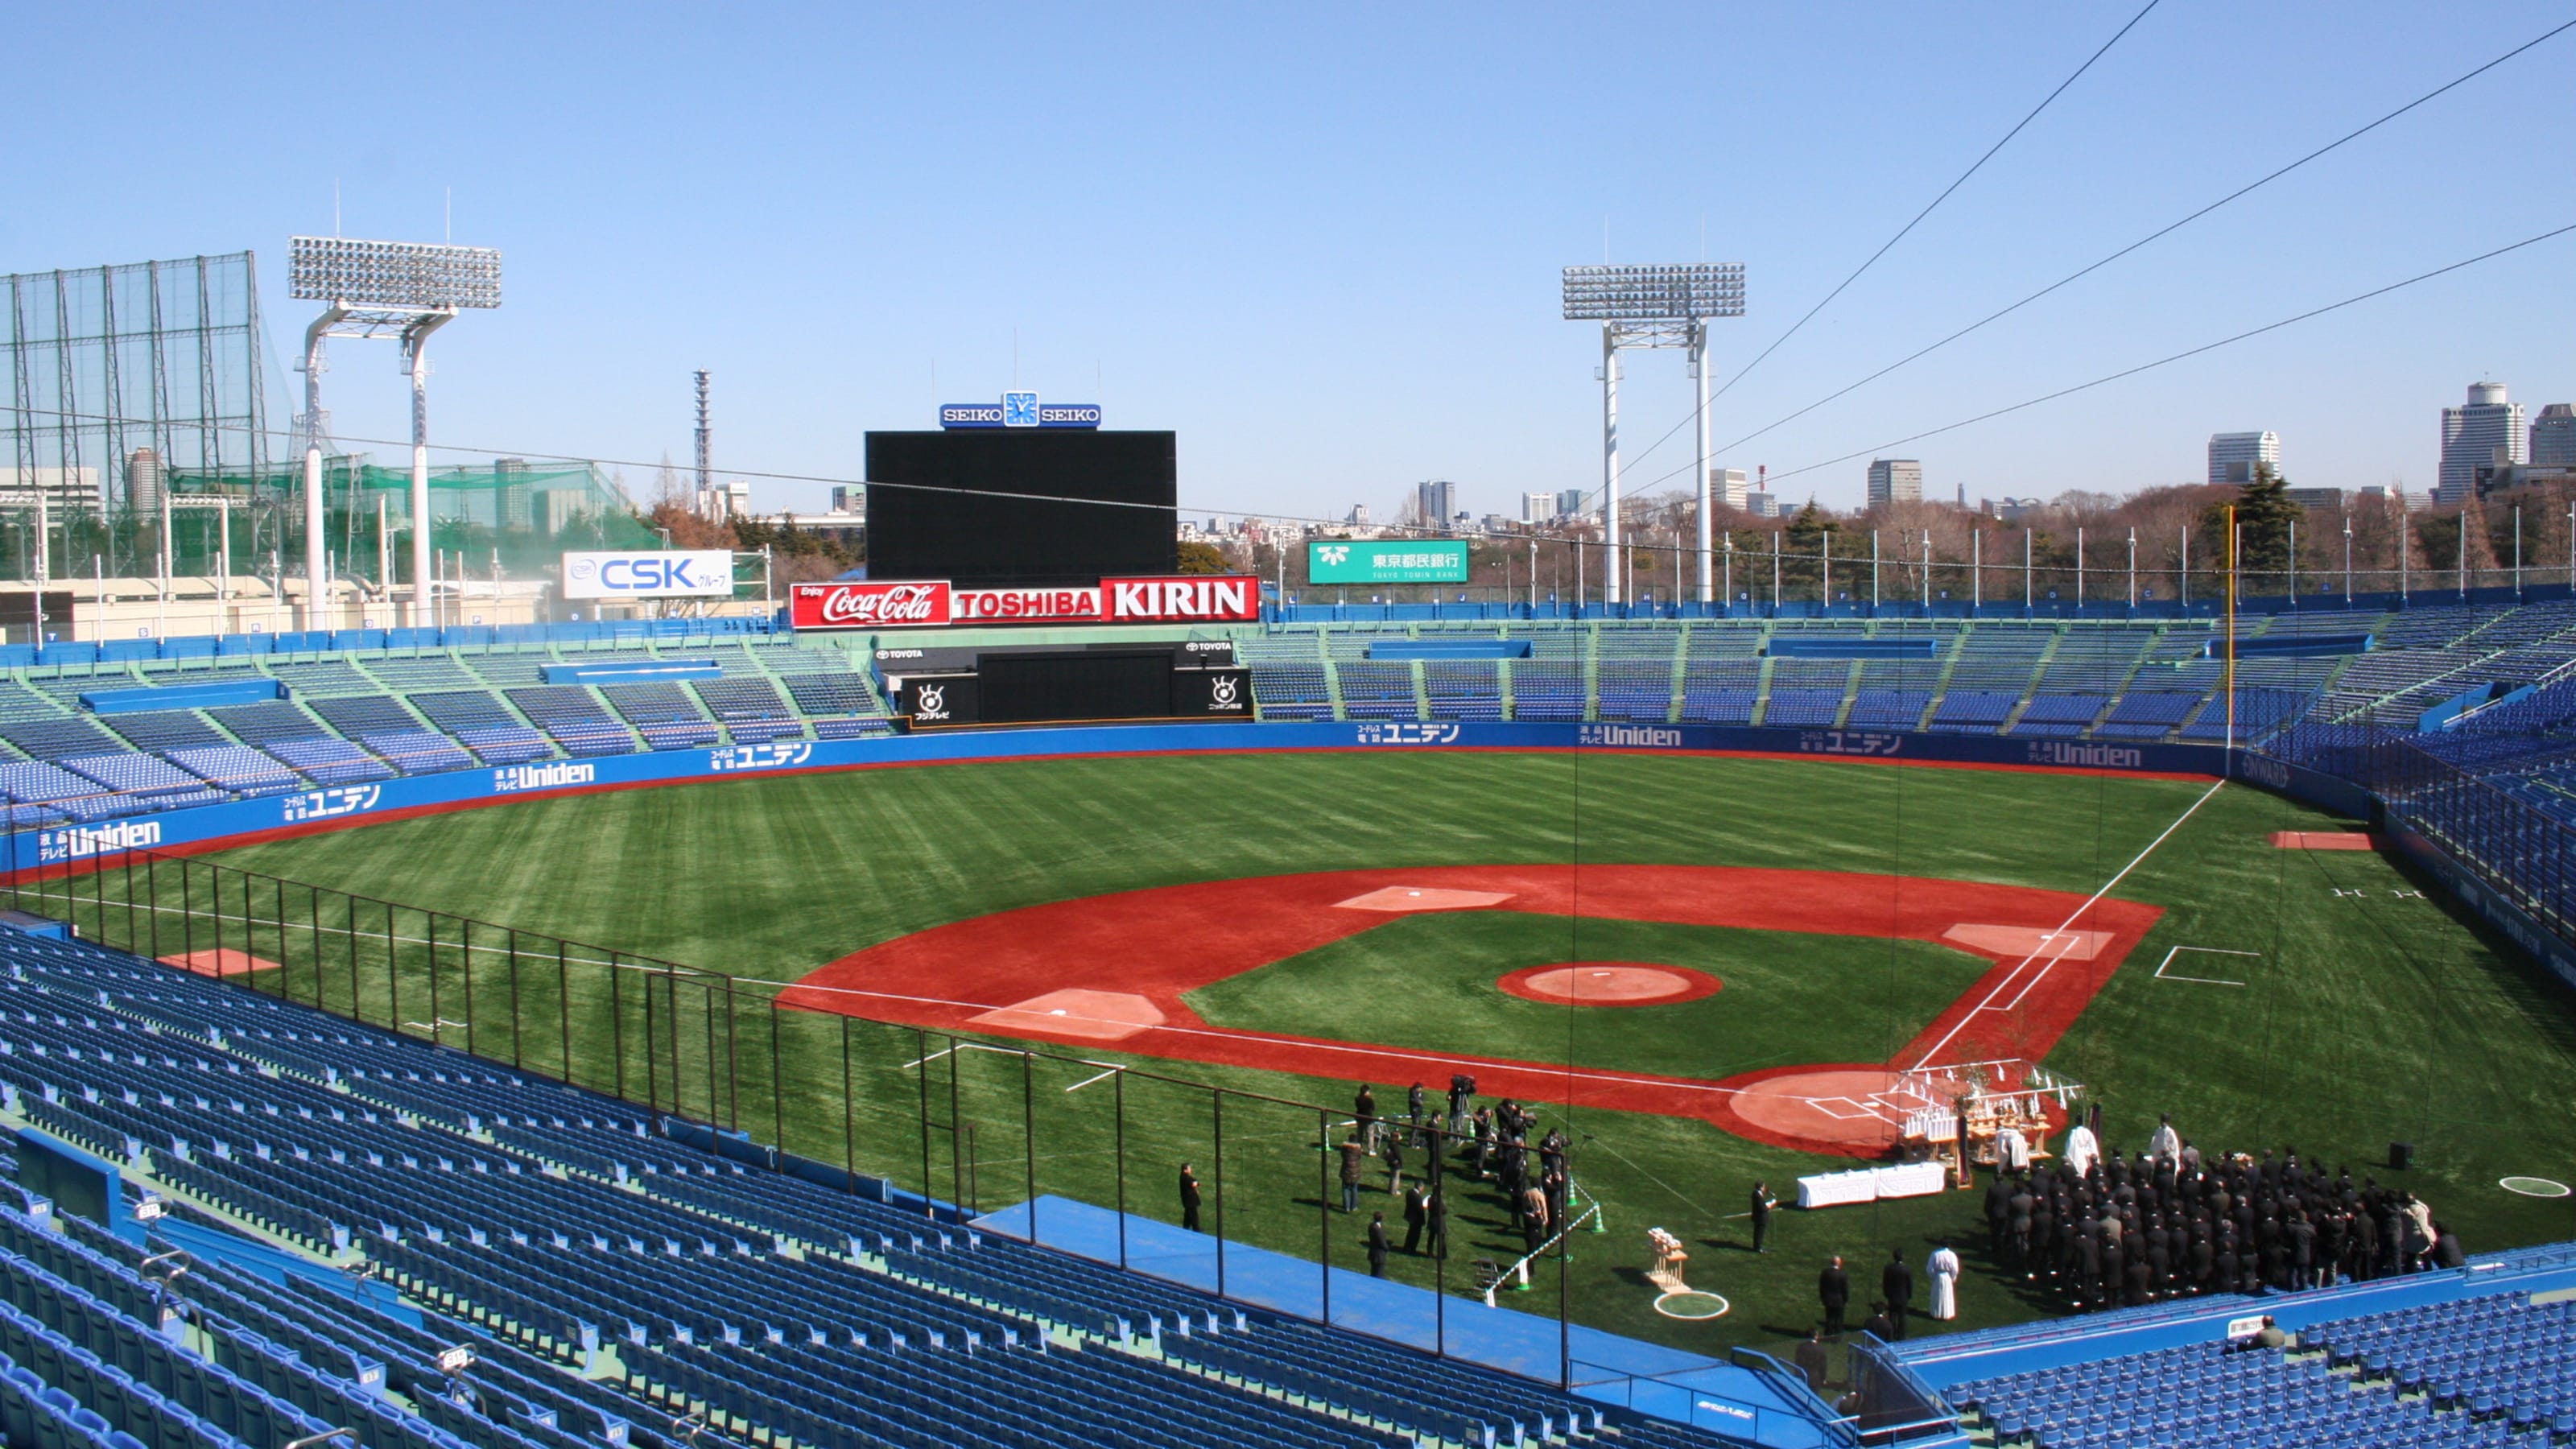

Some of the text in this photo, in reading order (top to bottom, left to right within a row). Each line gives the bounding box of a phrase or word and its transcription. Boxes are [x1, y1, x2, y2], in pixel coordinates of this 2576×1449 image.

[943, 409, 1099, 422] SEIKO SEIKO
[1372, 553, 1459, 568] 東京都民銀行
[601, 559, 697, 589] CSK
[800, 587, 825, 597] Enjoy
[1114, 581, 1245, 616] KIRIN
[823, 585, 936, 621] Coca-Cola
[958, 592, 1095, 616] TOSHIBA
[890, 650, 923, 658] TOYOTA
[1199, 642, 1232, 650] TOYOTA
[914, 711, 950, 720] フジテレビ
[1383, 724, 1459, 743] ユニデン
[1579, 735, 1603, 745] テレビ
[1604, 725, 1681, 746] Uniden
[1826, 732, 1901, 754] ユニデン
[736, 743, 811, 769] ユニデン
[2054, 742, 2140, 766] Uniden
[518, 762, 594, 789] Uniden
[2241, 754, 2289, 788] ONWARD
[495, 779, 518, 791] テレビ
[308, 784, 381, 818] ユニデン
[69, 821, 161, 857] Uniden
[39, 845, 68, 861] テレビ
